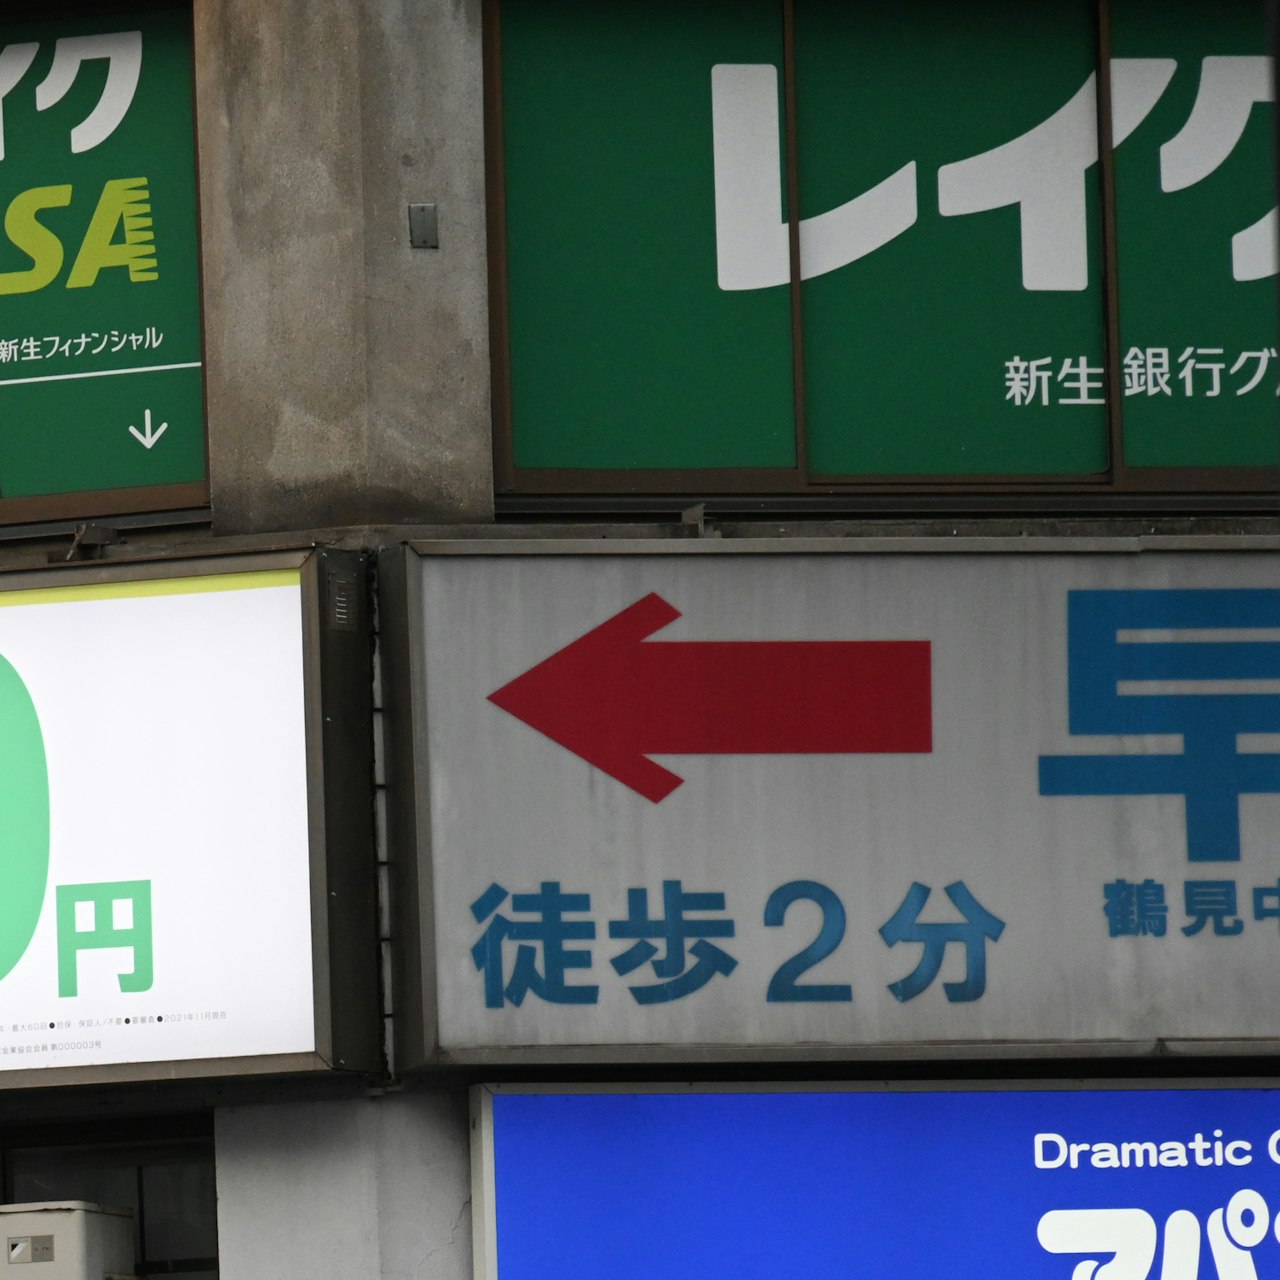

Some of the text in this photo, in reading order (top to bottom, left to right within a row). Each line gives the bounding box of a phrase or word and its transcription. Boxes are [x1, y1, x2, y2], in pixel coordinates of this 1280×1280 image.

[1004, 346, 1280, 406] 新生銀行グ
[470, 880, 1006, 1008] 徒歩2分
[1034, 1129, 1252, 1169] Dramatic
